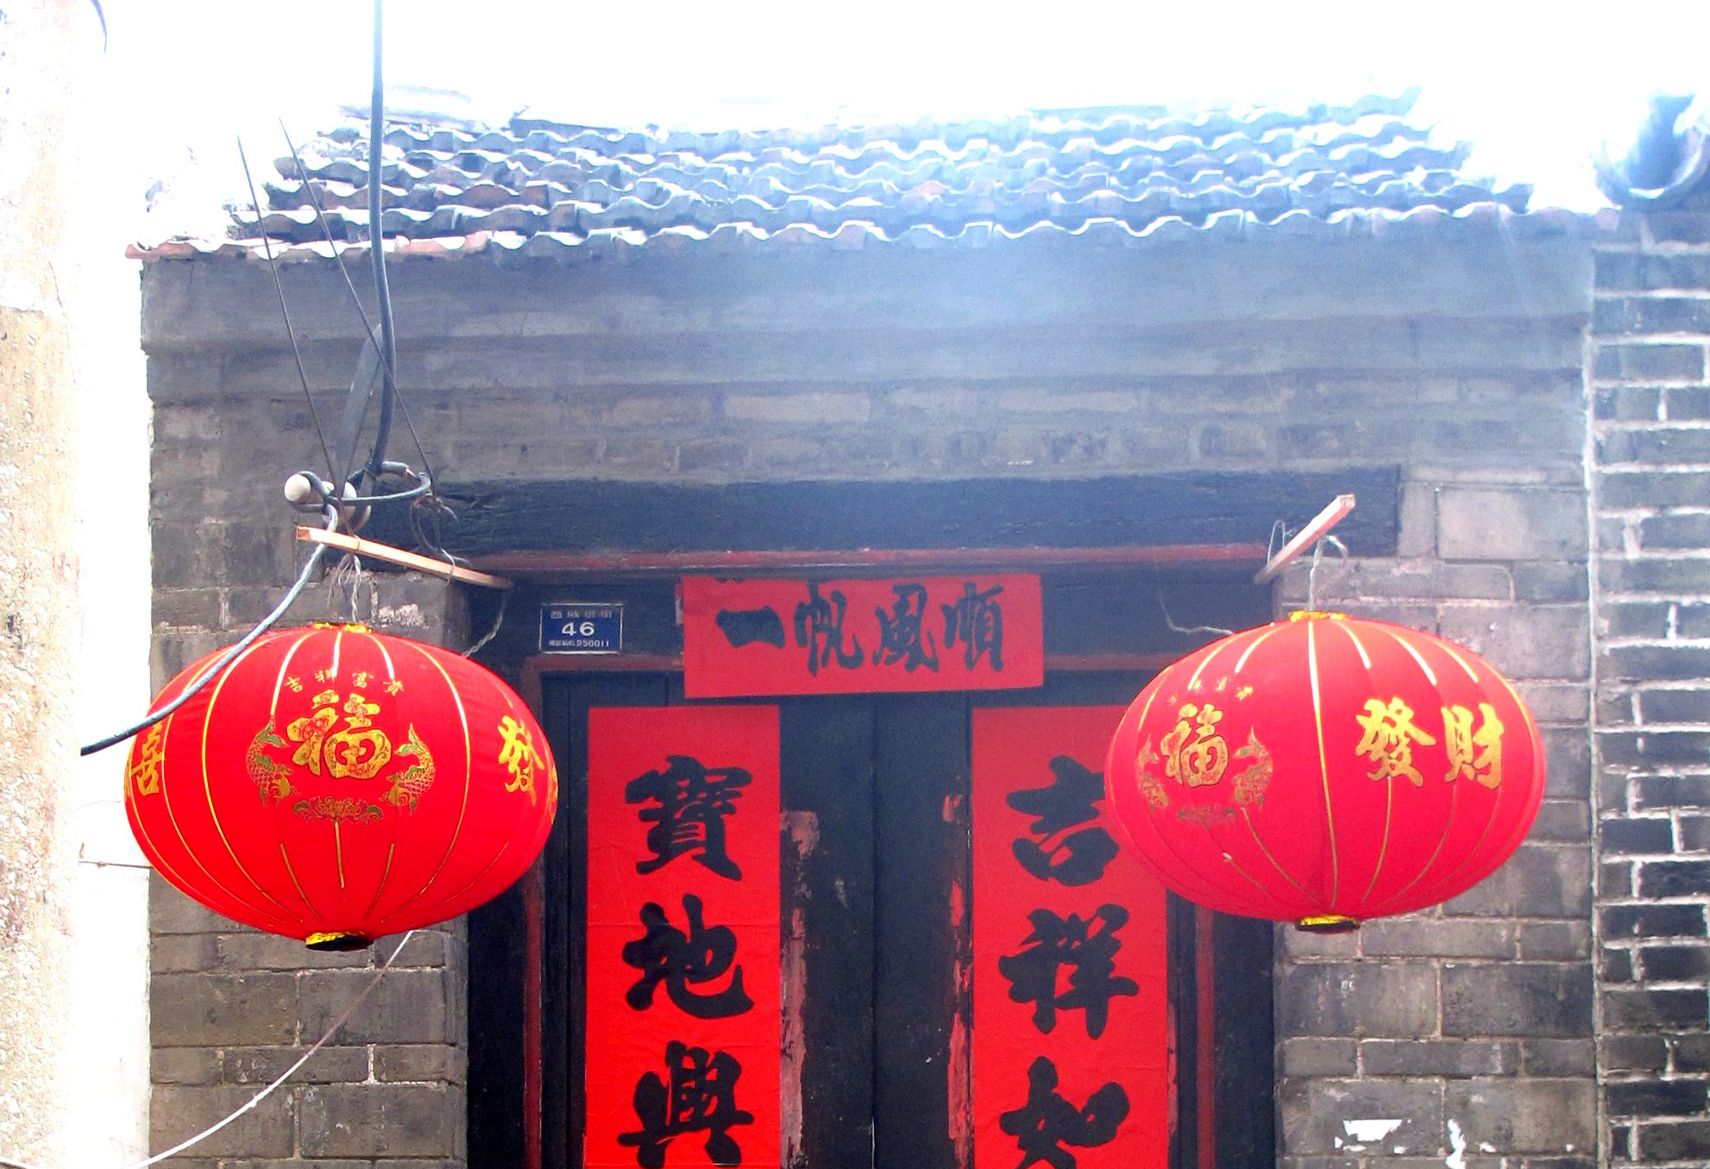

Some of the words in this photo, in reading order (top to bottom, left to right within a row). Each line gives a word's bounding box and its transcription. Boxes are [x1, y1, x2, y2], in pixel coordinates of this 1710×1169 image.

[561, 621, 595, 636] 46
[716, 581, 1004, 676] 一帆風順
[125, 721, 165, 797] 喜
[287, 689, 393, 780] 福
[498, 715, 558, 822] 發
[1160, 703, 1230, 788] 福
[1355, 696, 1505, 789] 發財
